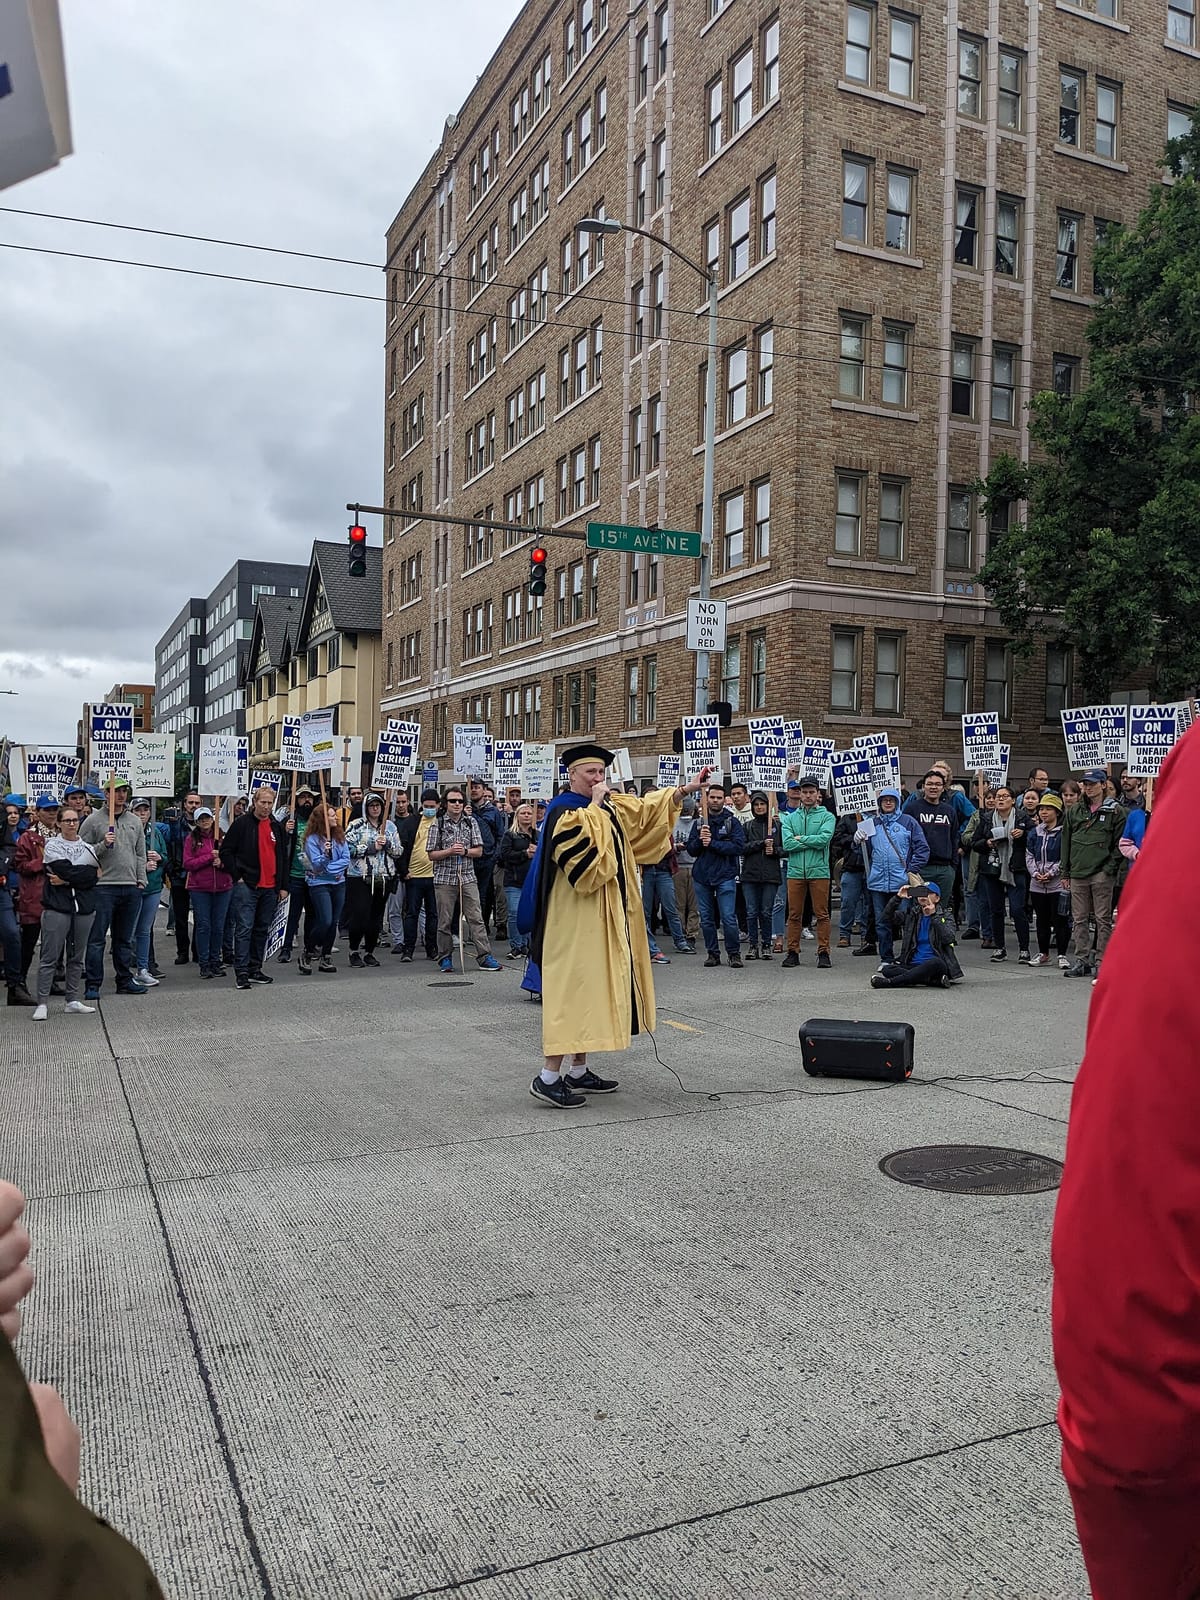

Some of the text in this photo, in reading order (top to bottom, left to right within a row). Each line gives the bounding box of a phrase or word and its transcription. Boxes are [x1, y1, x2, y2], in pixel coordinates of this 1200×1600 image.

[600, 530, 689, 551] 15TH AVE NE
[698, 603, 716, 615] NO
[695, 616, 719, 626] TURN
[700, 628, 713, 637] ON
[697, 639, 715, 648] RED
[92, 706, 132, 717] UAW
[1062, 708, 1097, 721] UAW
[1097, 706, 1125, 716] AW
[1132, 707, 1176, 719] UAW
[104, 719, 120, 729] ON
[284, 716, 301, 726] UA
[684, 717, 717, 728] UAW
[750, 718, 781, 729] UAW
[964, 714, 997, 725] UAW
[1101, 719, 1115, 728] ON
[389, 720, 419, 733] UAW
[784, 721, 801, 730] AW
[974, 726, 988, 735] ON
[1075, 723, 1089, 732] ON
[1144, 722, 1161, 733] ON
[93, 730, 131, 740] STRIKE
[694, 730, 708, 739] ON
[1067, 730, 1101, 743] STRIKE
[1102, 727, 1125, 737] RIKE
[380, 733, 413, 745] UAW
[755, 736, 786, 746] UAW
[806, 738, 833, 748] UAW
[855, 735, 886, 748] UAW
[965, 734, 998, 745] STRIKE
[1132, 733, 1174, 744] STRIKE
[97, 743, 127, 751] UNFAIR
[136, 737, 167, 752] Support
[686, 739, 718, 749] STRIKE
[969, 745, 995, 753] UNFAIR
[1073, 743, 1099, 753] UNFAIR
[286, 747, 303, 755] UNFA
[388, 746, 402, 754] ON
[503, 751, 515, 759] ON
[690, 751, 715, 759] UNFAIR
[764, 748, 777, 757] ON
[812, 749, 824, 757] ON
[1075, 750, 1099, 760] LABOR
[1136, 747, 1168, 756] UNFAIR
[28, 754, 56, 762] UAW
[58, 755, 79, 767] AW
[99, 752, 126, 760] LABOR
[286, 754, 305, 762] LABO
[377, 753, 410, 765] STRIKE
[830, 749, 868, 764] UAW
[870, 755, 888, 766] RIKE
[971, 752, 994, 760] LABOR
[93, 760, 132, 768] PRACTICE
[496, 758, 522, 766] STRIKE
[691, 758, 714, 766] LABOR
[755, 757, 786, 766] STRIKE
[803, 757, 830, 766] STRIKE
[966, 759, 1000, 767] PRACTICE
[1071, 757, 1105, 768] PRACTICE
[36, 765, 48, 773] ON
[136, 766, 164, 775] Support
[380, 764, 405, 774] UNFAIR
[687, 765, 719, 774] PRAE
[758, 767, 782, 775] UNFAIR
[843, 763, 859, 775] ON
[871, 766, 887, 774] FAIR
[1130, 765, 1160, 774] PRACT
[28, 774, 56, 782] STRIKE
[254, 771, 280, 781] UAW
[380, 772, 403, 780] LABOR
[835, 773, 871, 787] STRIKE
[873, 773, 886, 781] BOR
[374, 778, 407, 787] PRACTICE
[755, 781, 786, 789] PRACTICE
[872, 779, 892, 788] CTICE
[840, 784, 869, 796] UNFAIR
[843, 792, 869, 804] LABOR
[838, 799, 876, 812] PRACTICE
[919, 813, 951, 825] NASA
